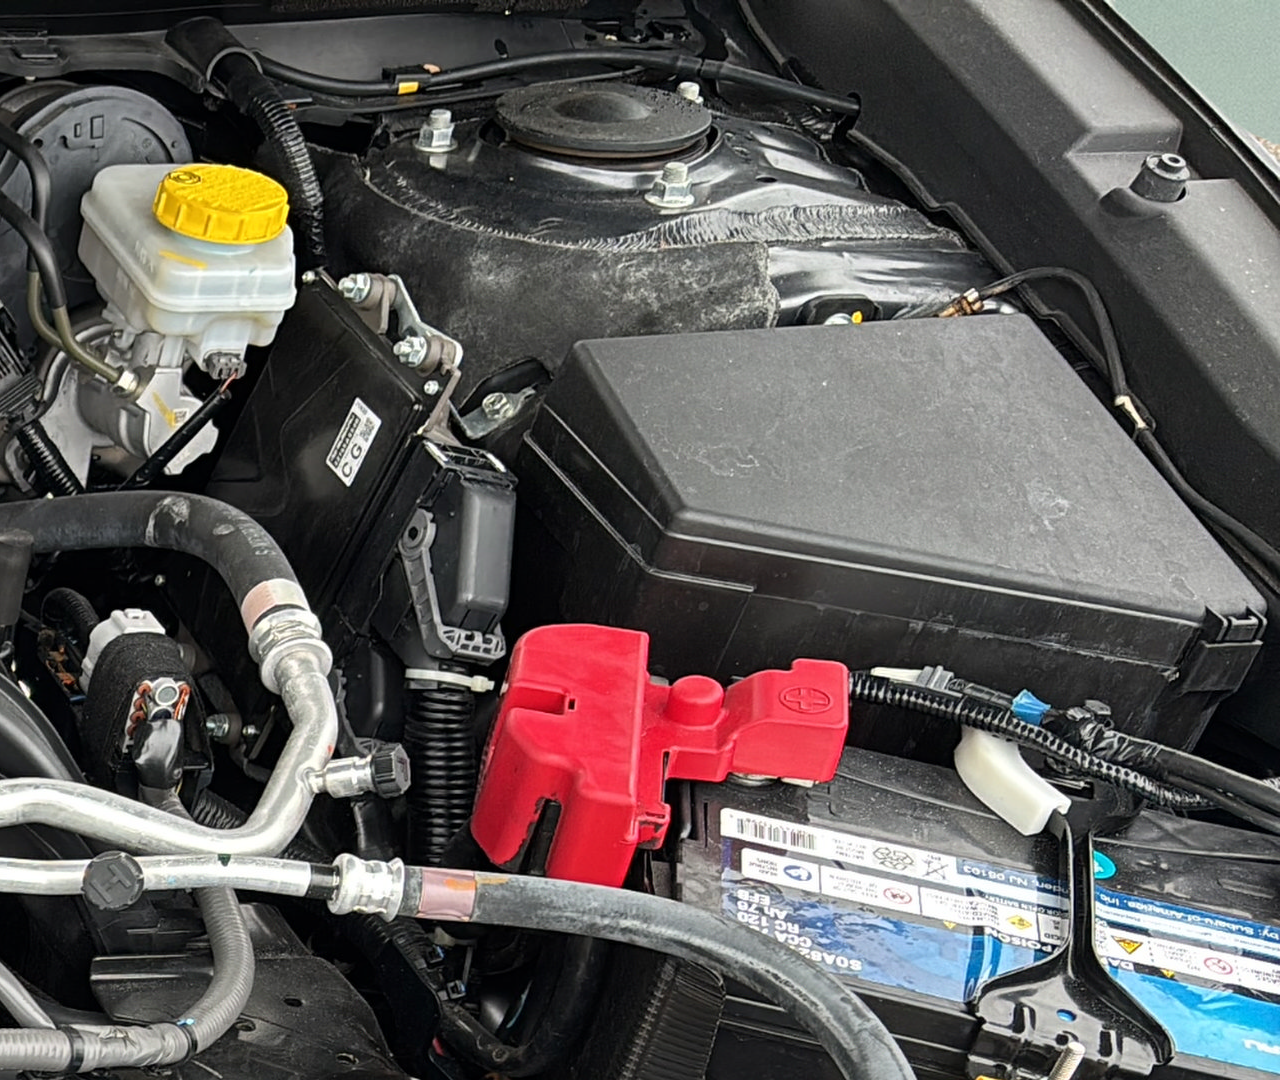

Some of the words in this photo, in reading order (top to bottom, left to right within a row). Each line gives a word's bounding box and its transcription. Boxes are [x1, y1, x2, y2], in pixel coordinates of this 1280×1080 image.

[962, 864, 1006, 881] 08103
[1009, 875, 1029, 886] NJ
[736, 889, 772, 906] EFB
[1095, 892, 1120, 906] Inc.
[736, 911, 771, 927] 120
[763, 905, 789, 920] Ah
[773, 919, 800, 935] RC
[1201, 916, 1255, 936] Subaru
